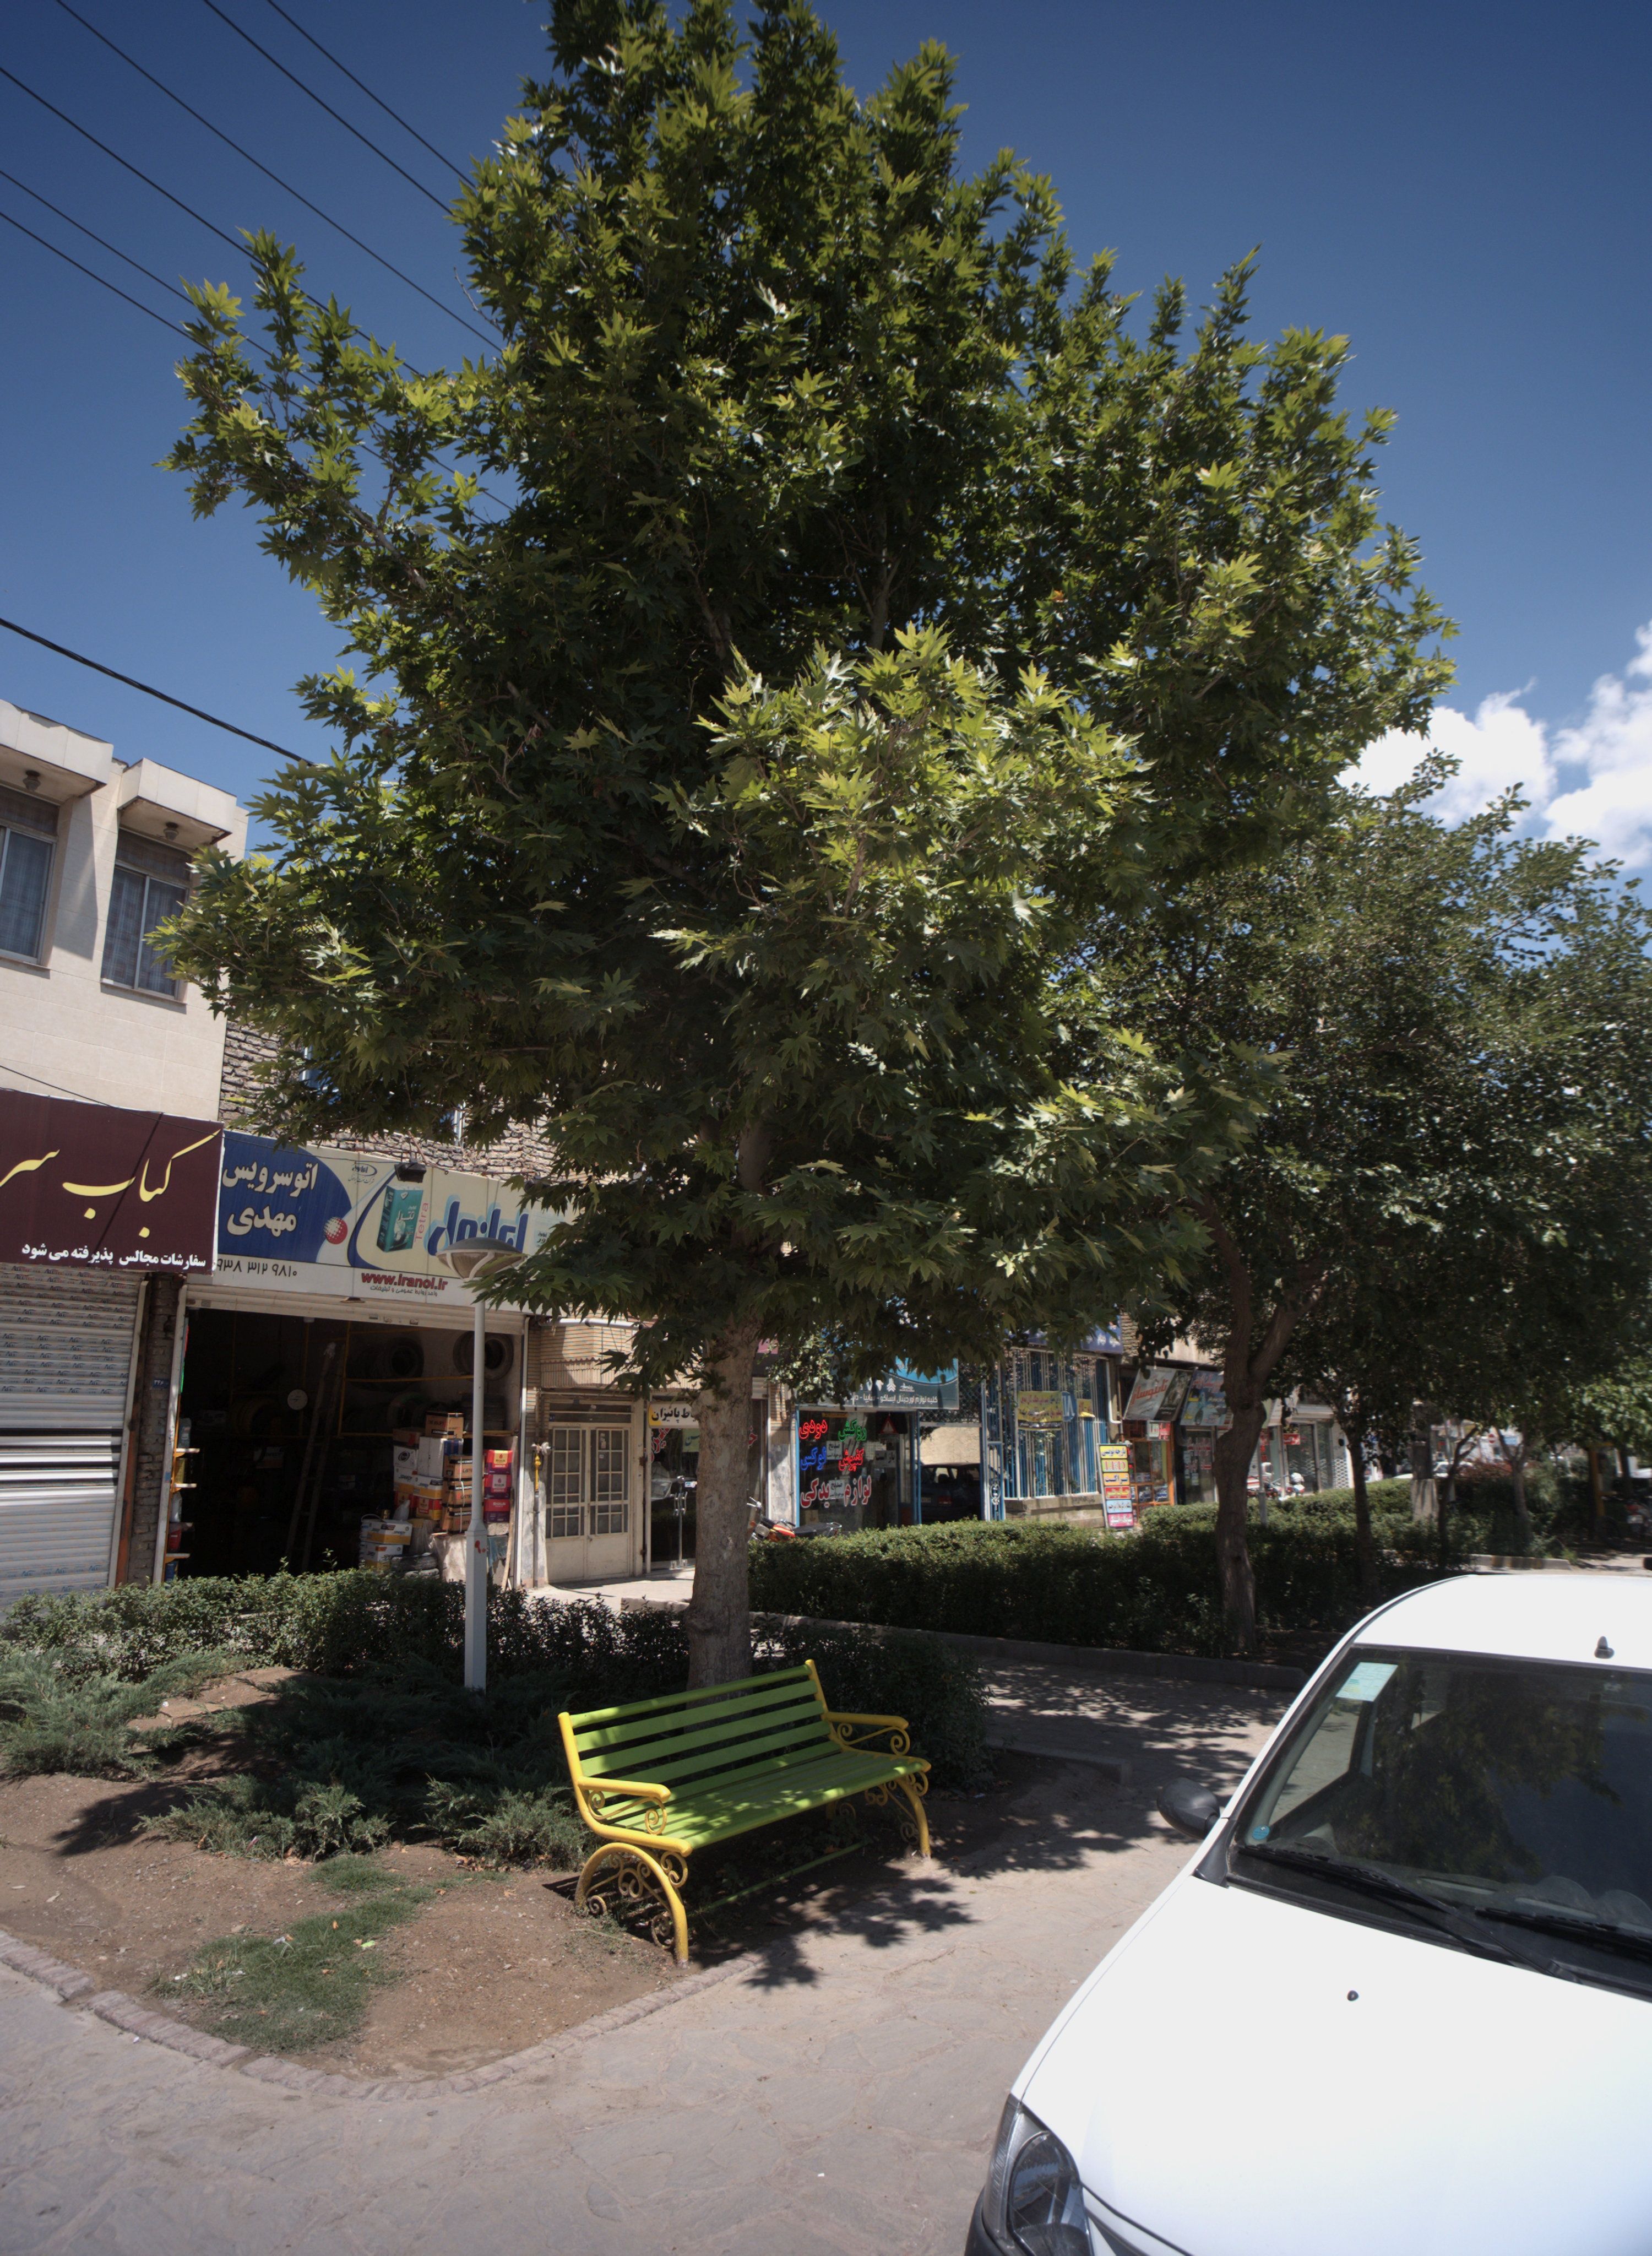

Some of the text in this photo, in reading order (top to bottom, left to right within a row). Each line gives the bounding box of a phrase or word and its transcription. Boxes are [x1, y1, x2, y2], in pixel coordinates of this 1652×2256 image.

[62, 1129, 221, 1238] کباب
[222, 1160, 318, 1197] اتوسرویس
[227, 1205, 297, 1237] مهدی
[414, 1202, 429, 1243] Tetra
[119, 1250, 160, 1268] مجالس
[161, 1253, 206, 1270] سفارشات
[361, 1272, 448, 1290] www.iranol.ir
[798, 1418, 867, 1441] روکش دودی
[800, 1446, 827, 1471] لوکس
[1104, 1461, 1126, 1471] LED
[800, 1475, 872, 1508] لوازم یدکی
